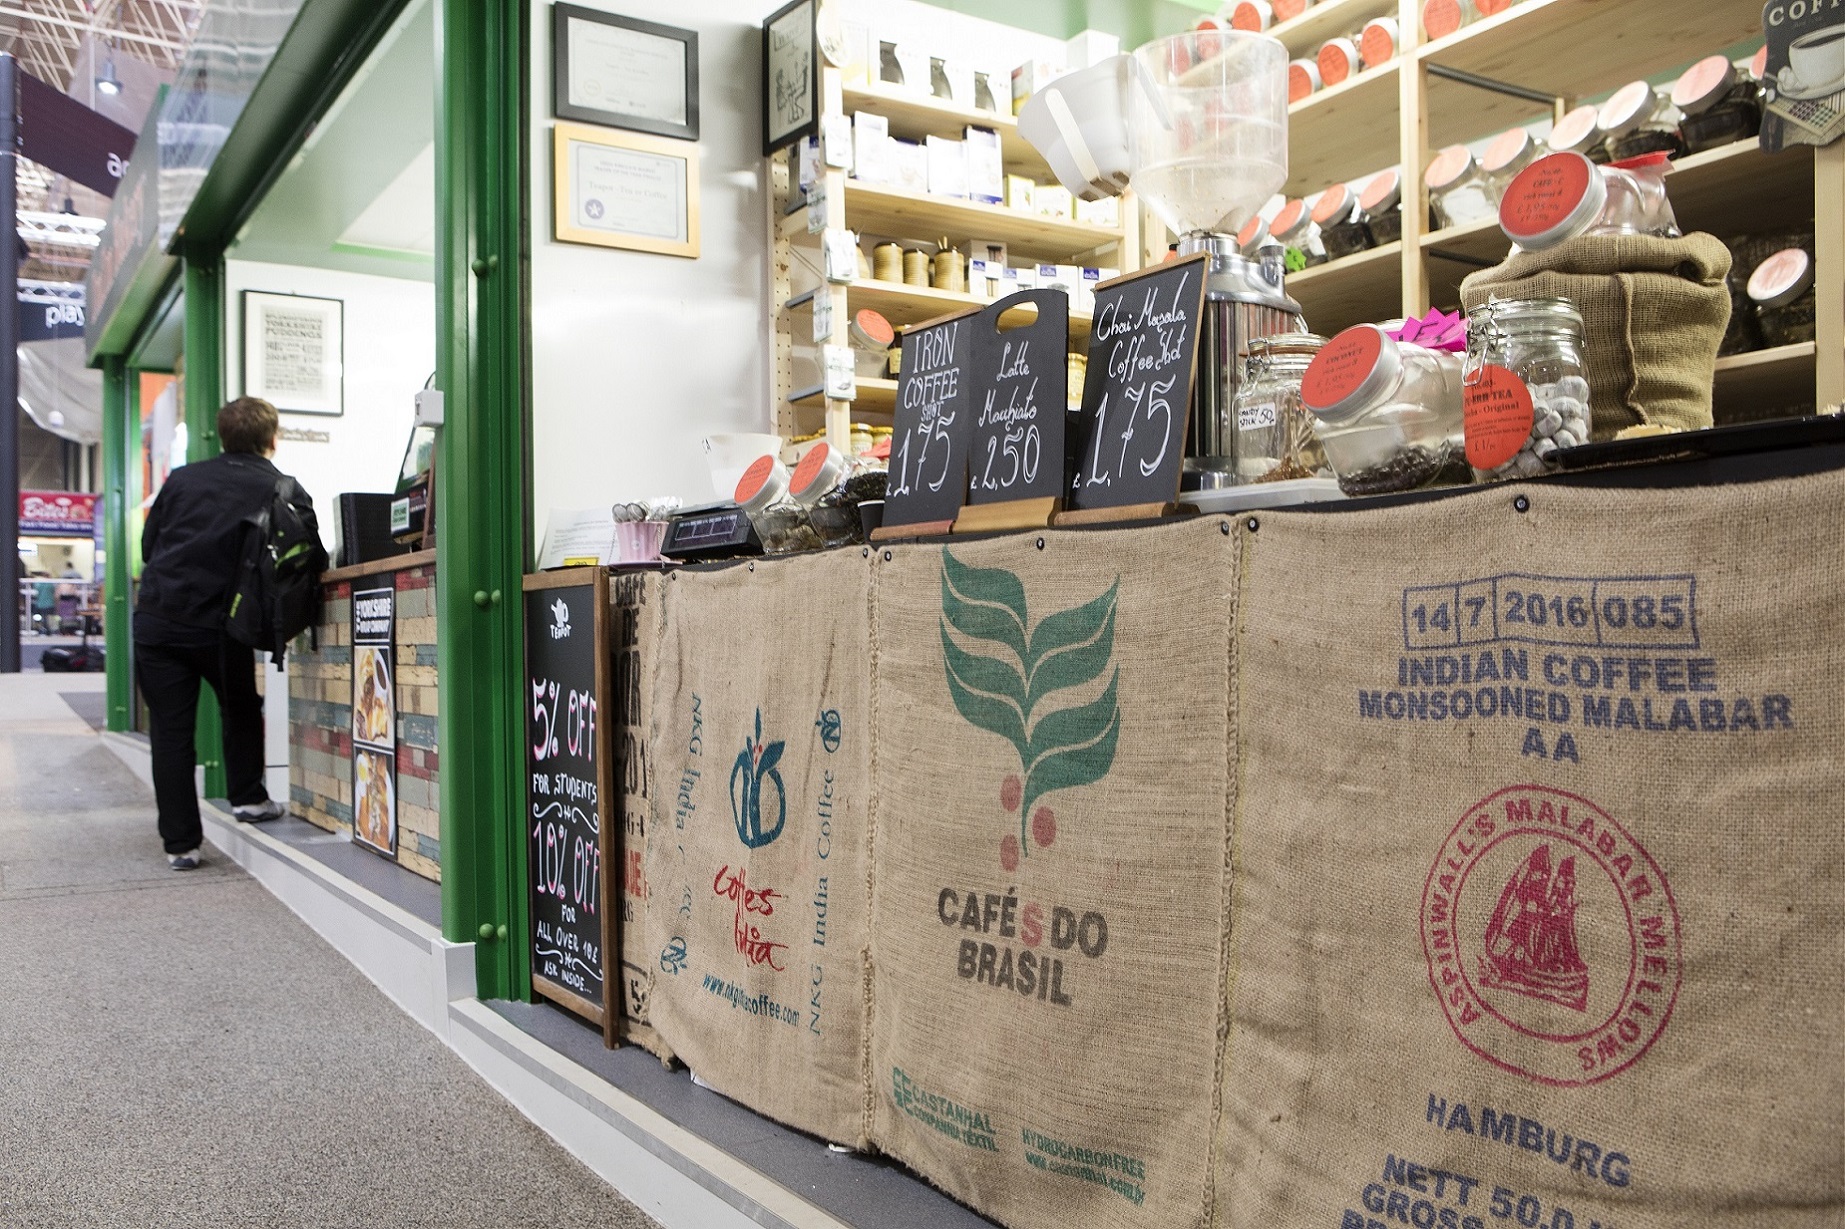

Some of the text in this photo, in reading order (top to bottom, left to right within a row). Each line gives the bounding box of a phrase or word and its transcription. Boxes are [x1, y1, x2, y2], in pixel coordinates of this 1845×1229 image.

[1097, 294, 1132, 341] Chai
[912, 321, 959, 374] IRON
[996, 340, 1030, 382] Latte
[1108, 333, 1154, 384] Coffee
[903, 367, 960, 410] COFFEE
[920, 400, 945, 422] SHOT
[549, 623, 572, 640] TEAPOT
[1411, 591, 1684, 633] 14 7 2016 085
[1398, 648, 1718, 693] INDIAN COFFEE
[532, 676, 597, 763] 5% OFF
[1358, 685, 1796, 734] MONSOONED MALABAR
[1520, 727, 1580, 765] AA
[533, 772, 598, 806] FOR STUDENTS
[675, 767, 702, 831] India
[533, 821, 568, 900] 10%
[574, 835, 600, 916] OFF
[561, 903, 576, 924] FOR
[809, 770, 835, 1036] NKG India Coffee
[937, 886, 1109, 960] CAFÉS DO
[536, 920, 553, 944] ALL
[555, 926, 579, 953] OVER
[1430, 799, 1669, 1072] ASPINWALL'S MALABAR MELLOWS
[543, 960, 559, 978] ASK
[956, 938, 1072, 1007] BRASIL
[912, 1084, 997, 1136] CASTANHAL
[1425, 1093, 1632, 1188] HAMBURG
[1382, 1153, 1479, 1207] NETT
